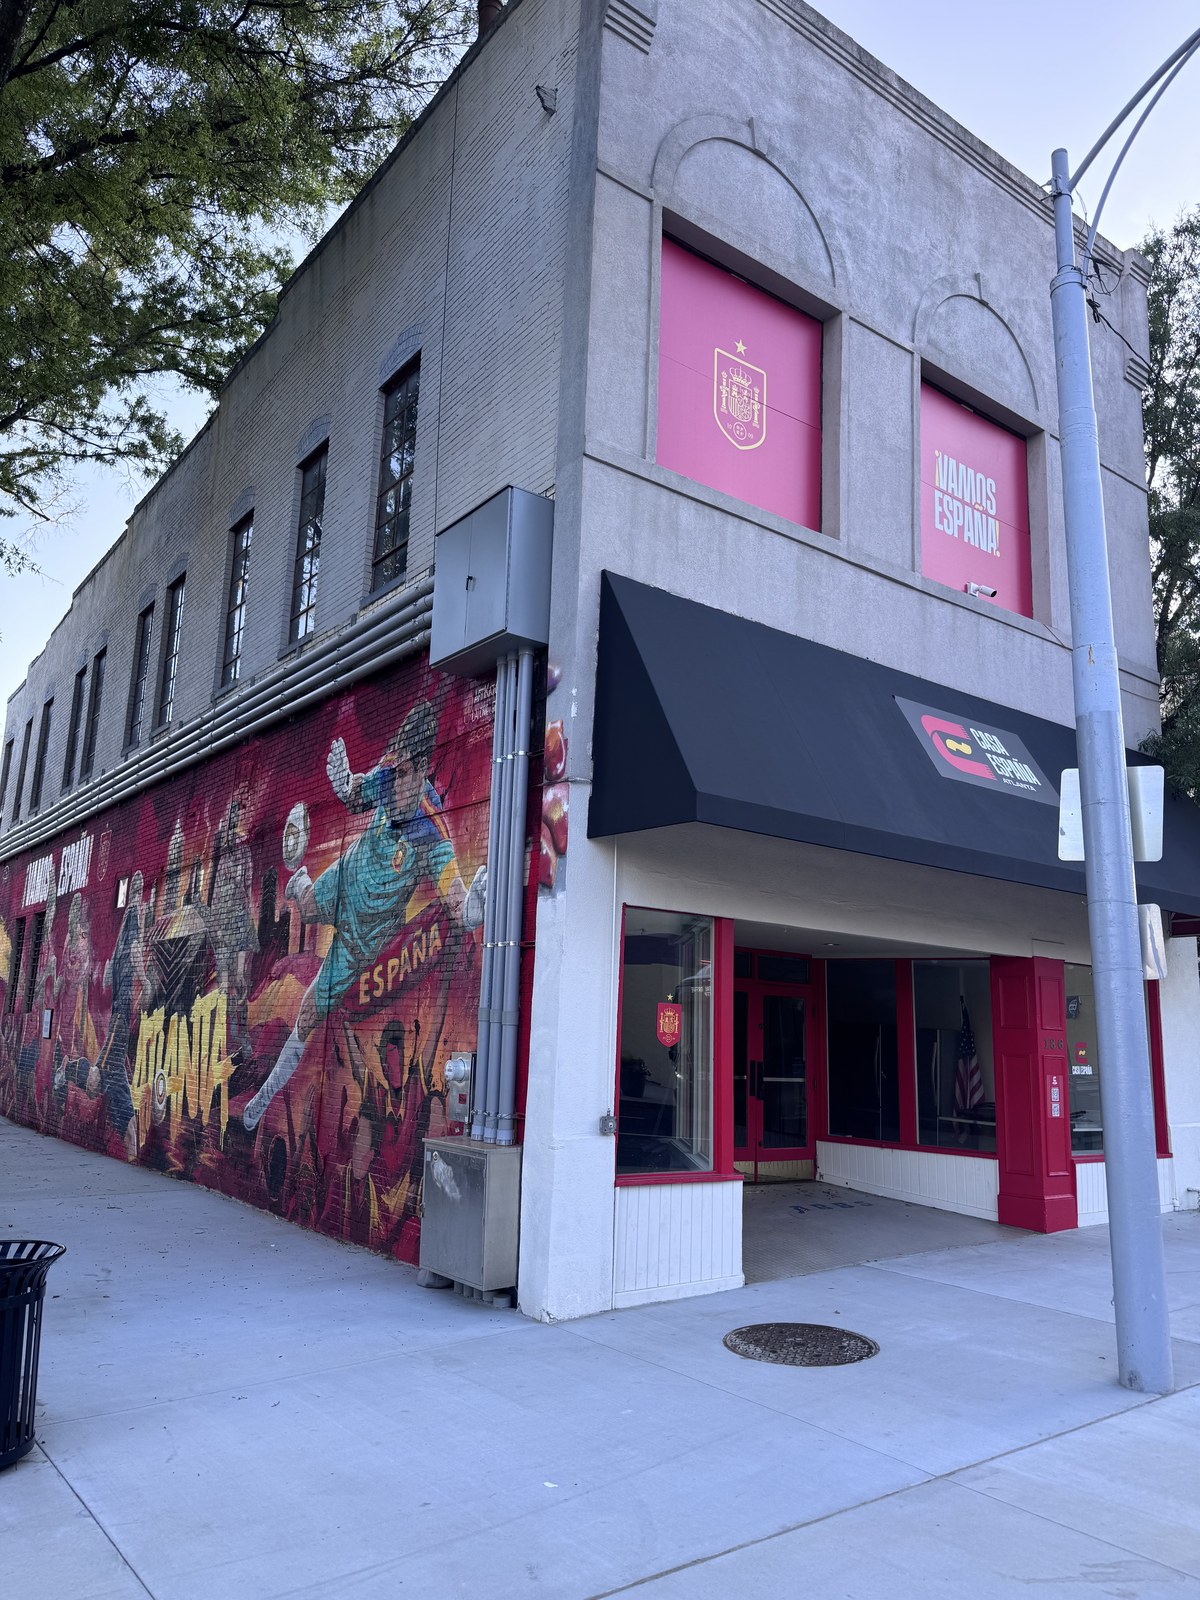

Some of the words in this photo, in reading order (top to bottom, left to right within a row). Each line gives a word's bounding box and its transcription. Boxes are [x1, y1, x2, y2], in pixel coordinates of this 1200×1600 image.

[934, 489, 1001, 558] ESPAÑA!
[969, 727, 1010, 757] CASA
[985, 752, 1042, 786] ESPAÑA
[1003, 777, 1037, 792] ATLANTA
[359, 922, 443, 1005] ESPAÑA
